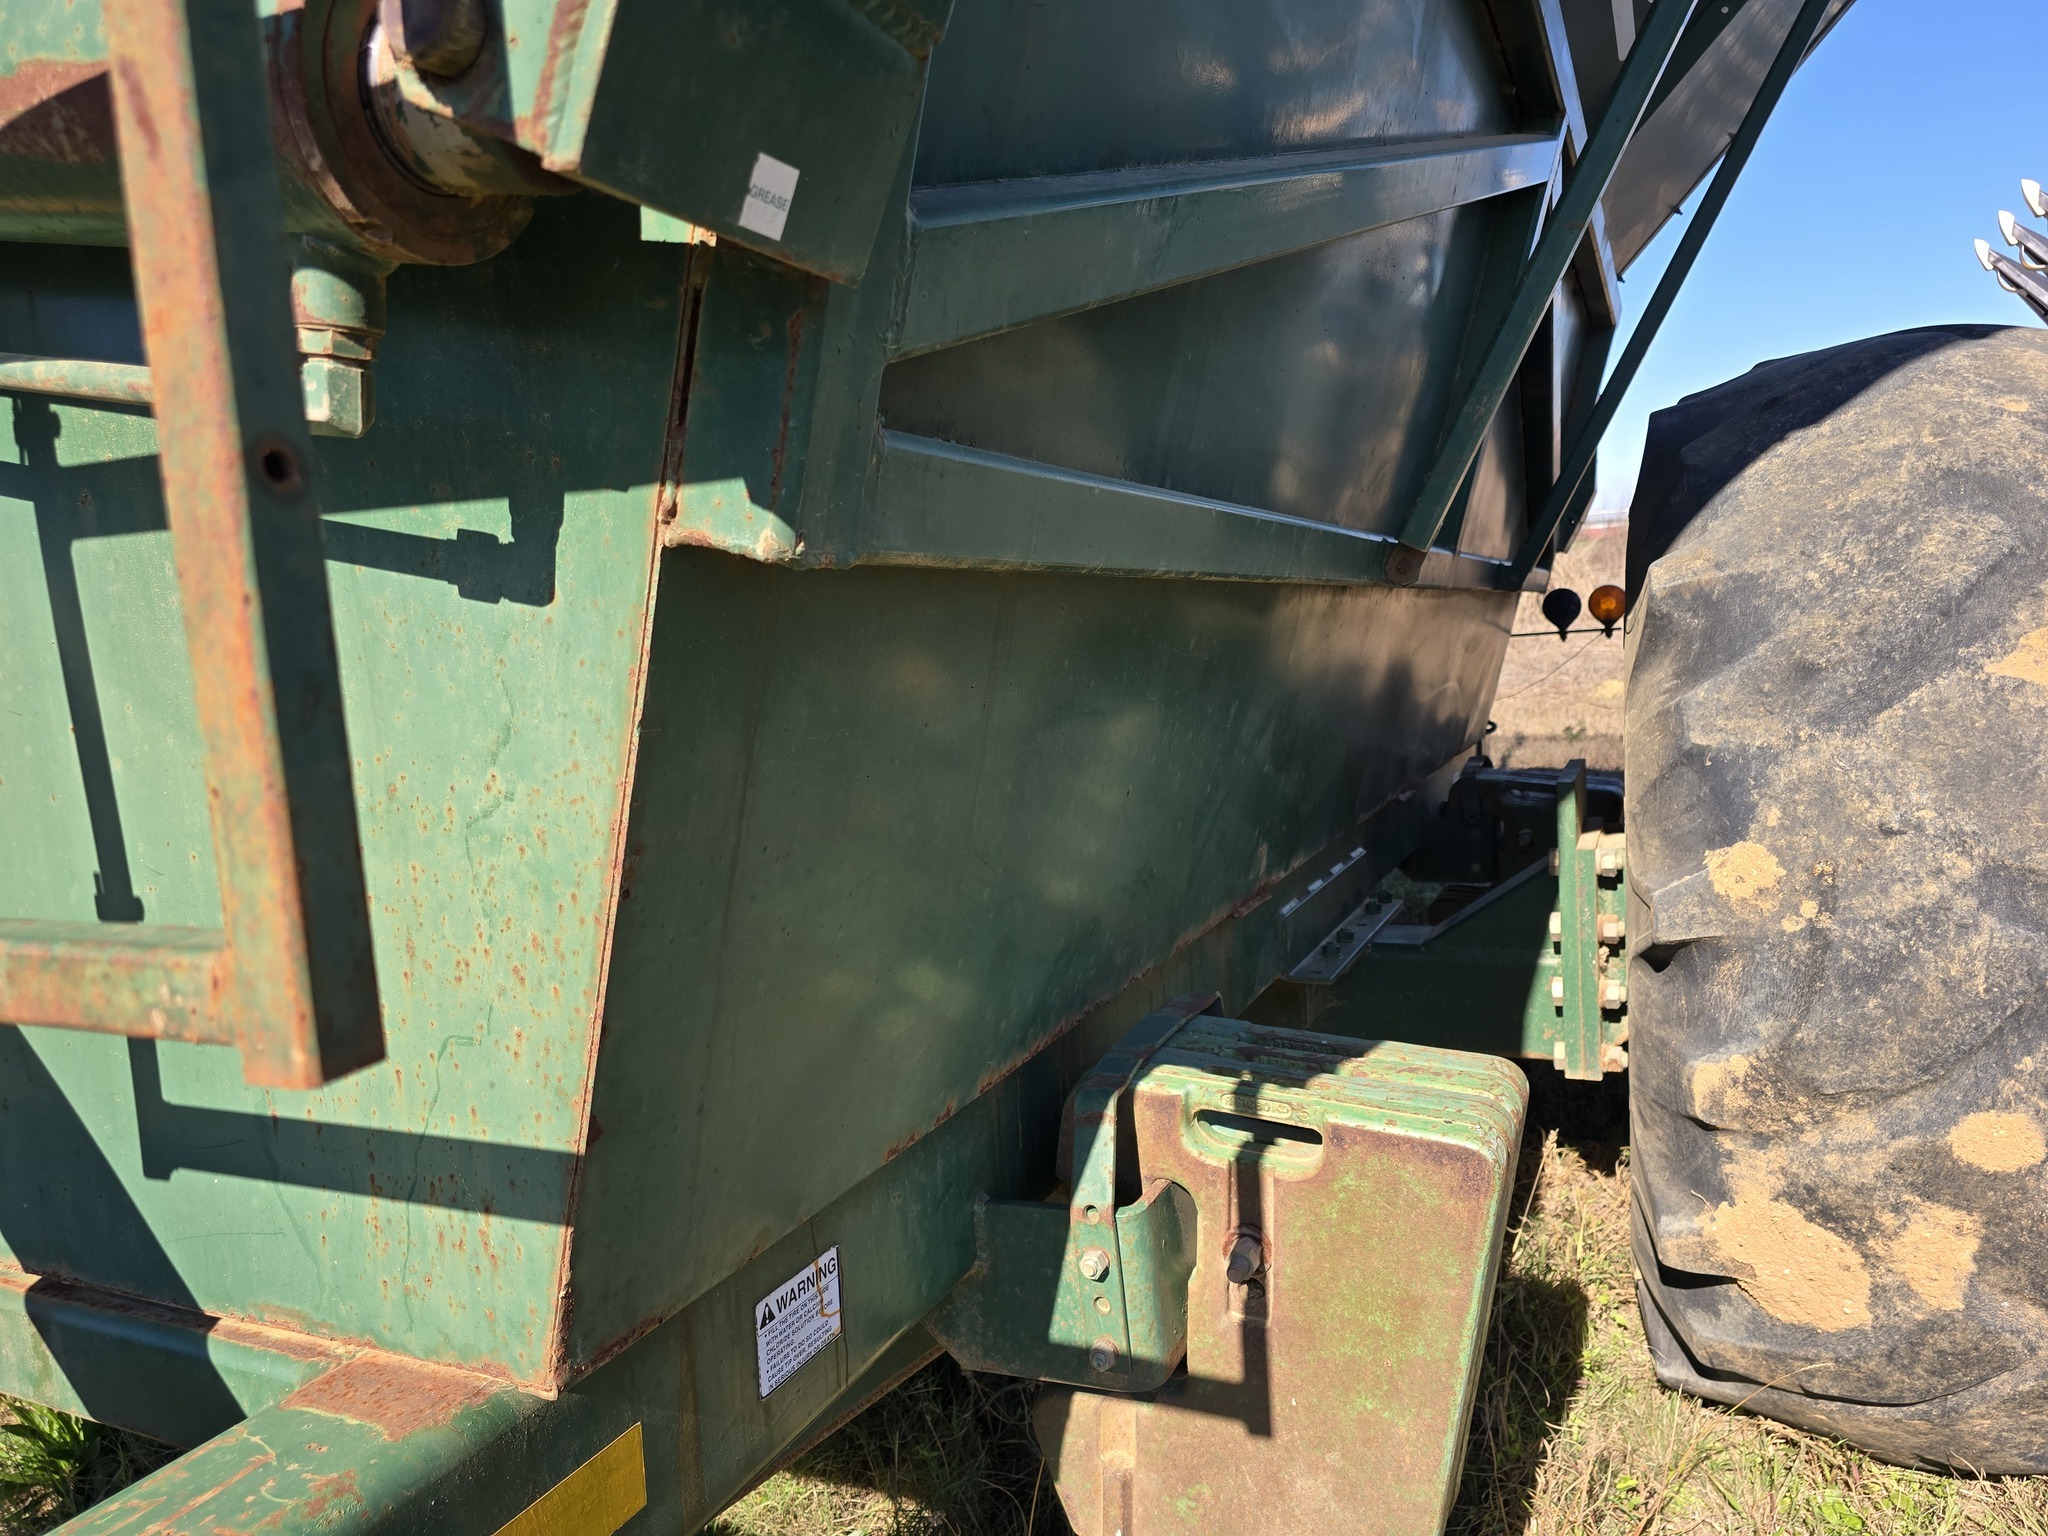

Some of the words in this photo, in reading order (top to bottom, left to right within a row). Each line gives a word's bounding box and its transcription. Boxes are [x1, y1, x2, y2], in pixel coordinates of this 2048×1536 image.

[750, 184, 790, 211] GREASE
[776, 1255, 836, 1315] WARNING
[766, 1333, 778, 1347] WITH
[779, 1319, 795, 1337] WATER
[796, 1314, 802, 1324] OR
[766, 1332, 790, 1356] CHLORIDE
[792, 1313, 814, 1336] SOLUTION
[768, 1324, 777, 1336] FILL
[779, 1316, 787, 1328] THE
[789, 1307, 799, 1319] TIRE
[800, 1301, 807, 1311] ON
[808, 1292, 818, 1304] THIS
[767, 1338, 794, 1365] OPERATING.
[768, 1364, 784, 1383] CAUSE
[808, 1325, 832, 1349] RESULTING
[768, 1382, 773, 1391] IN
[775, 1363, 795, 1386] SERIOUS
[796, 1349, 812, 1368] INJURY
[814, 1343, 820, 1353] OR
[770, 1350, 789, 1372] FAILURE
[791, 1344, 797, 1354] TO
[798, 1338, 805, 1349] DO
[806, 1332, 812, 1342] SO
[813, 1319, 828, 1336] COULD
